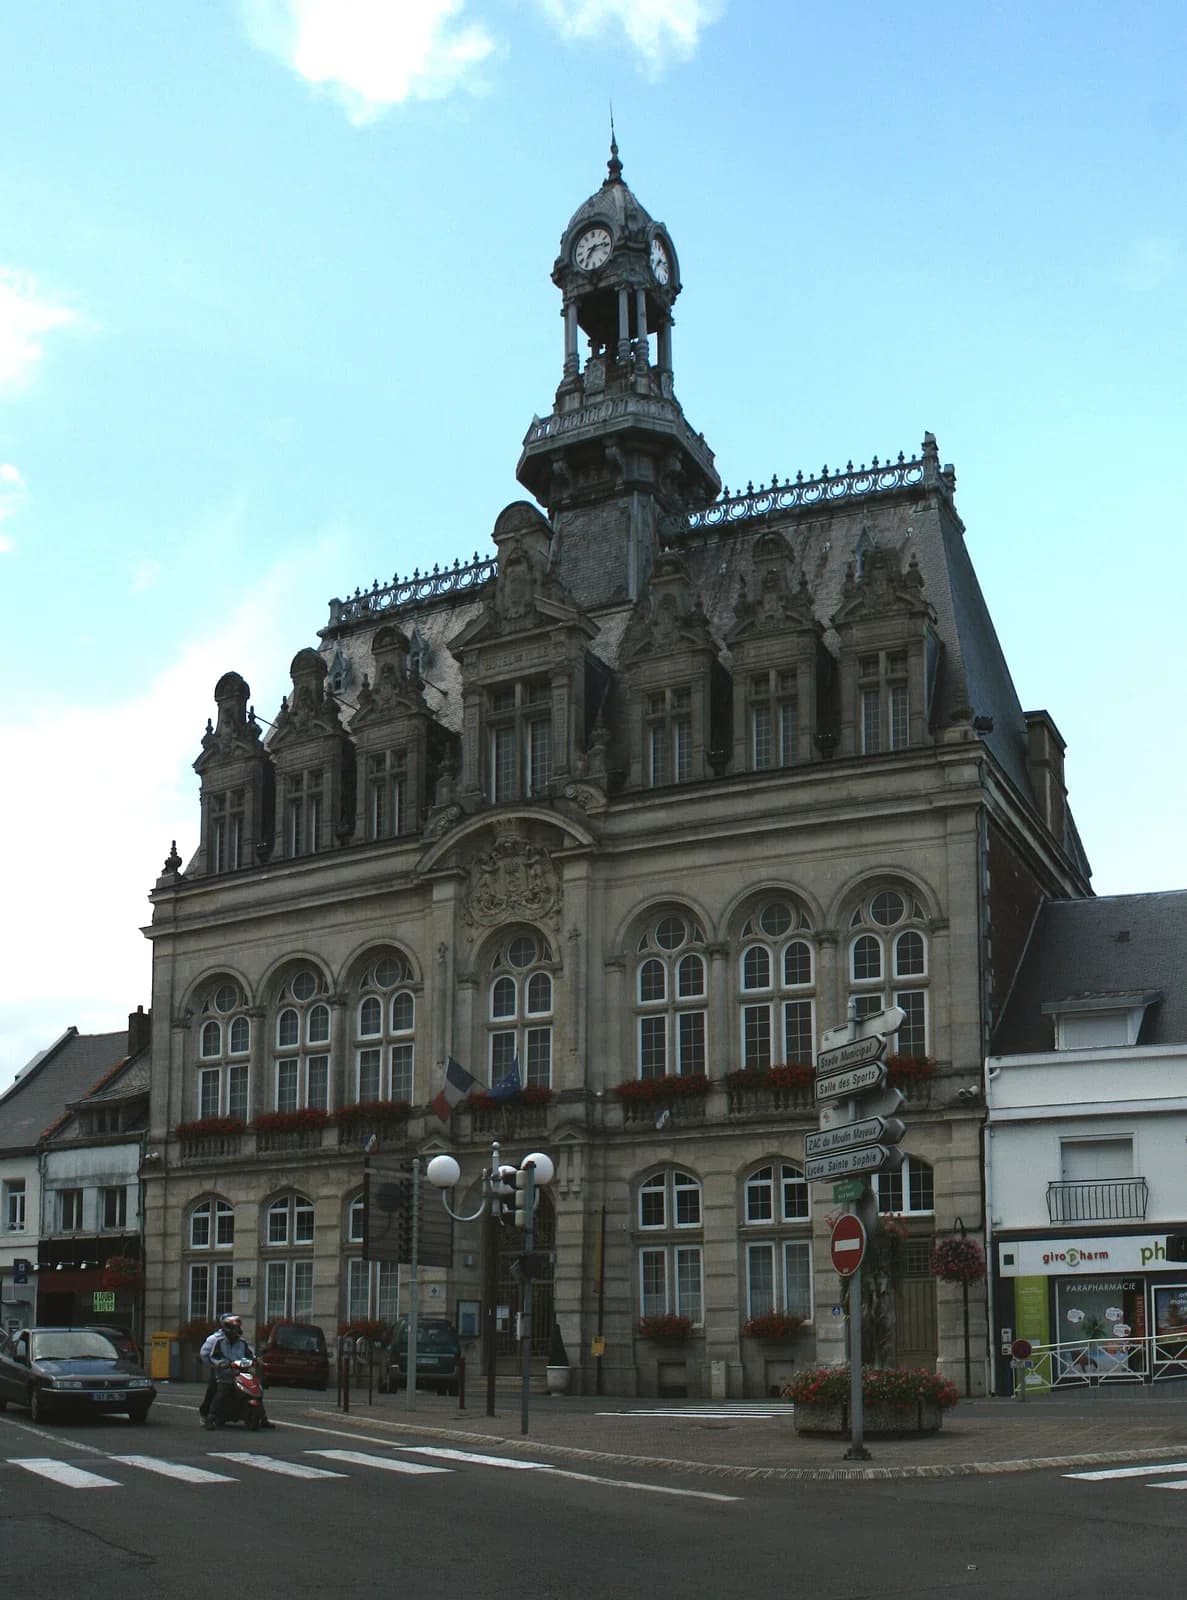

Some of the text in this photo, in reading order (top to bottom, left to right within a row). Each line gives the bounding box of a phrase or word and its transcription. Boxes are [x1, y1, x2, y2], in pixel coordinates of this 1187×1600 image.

[820, 1055, 838, 1069] Stade
[819, 1070, 876, 1095] Salle des Sports
[808, 1137, 821, 1151] ZAC
[822, 1136, 830, 1148] du
[831, 1130, 851, 1144] Moulin
[807, 1152, 877, 1176] Lycée Sainte Sophie
[1042, 1248, 1109, 1267] giropharm
[1065, 1282, 1137, 1293] PARAPHARMACIE
